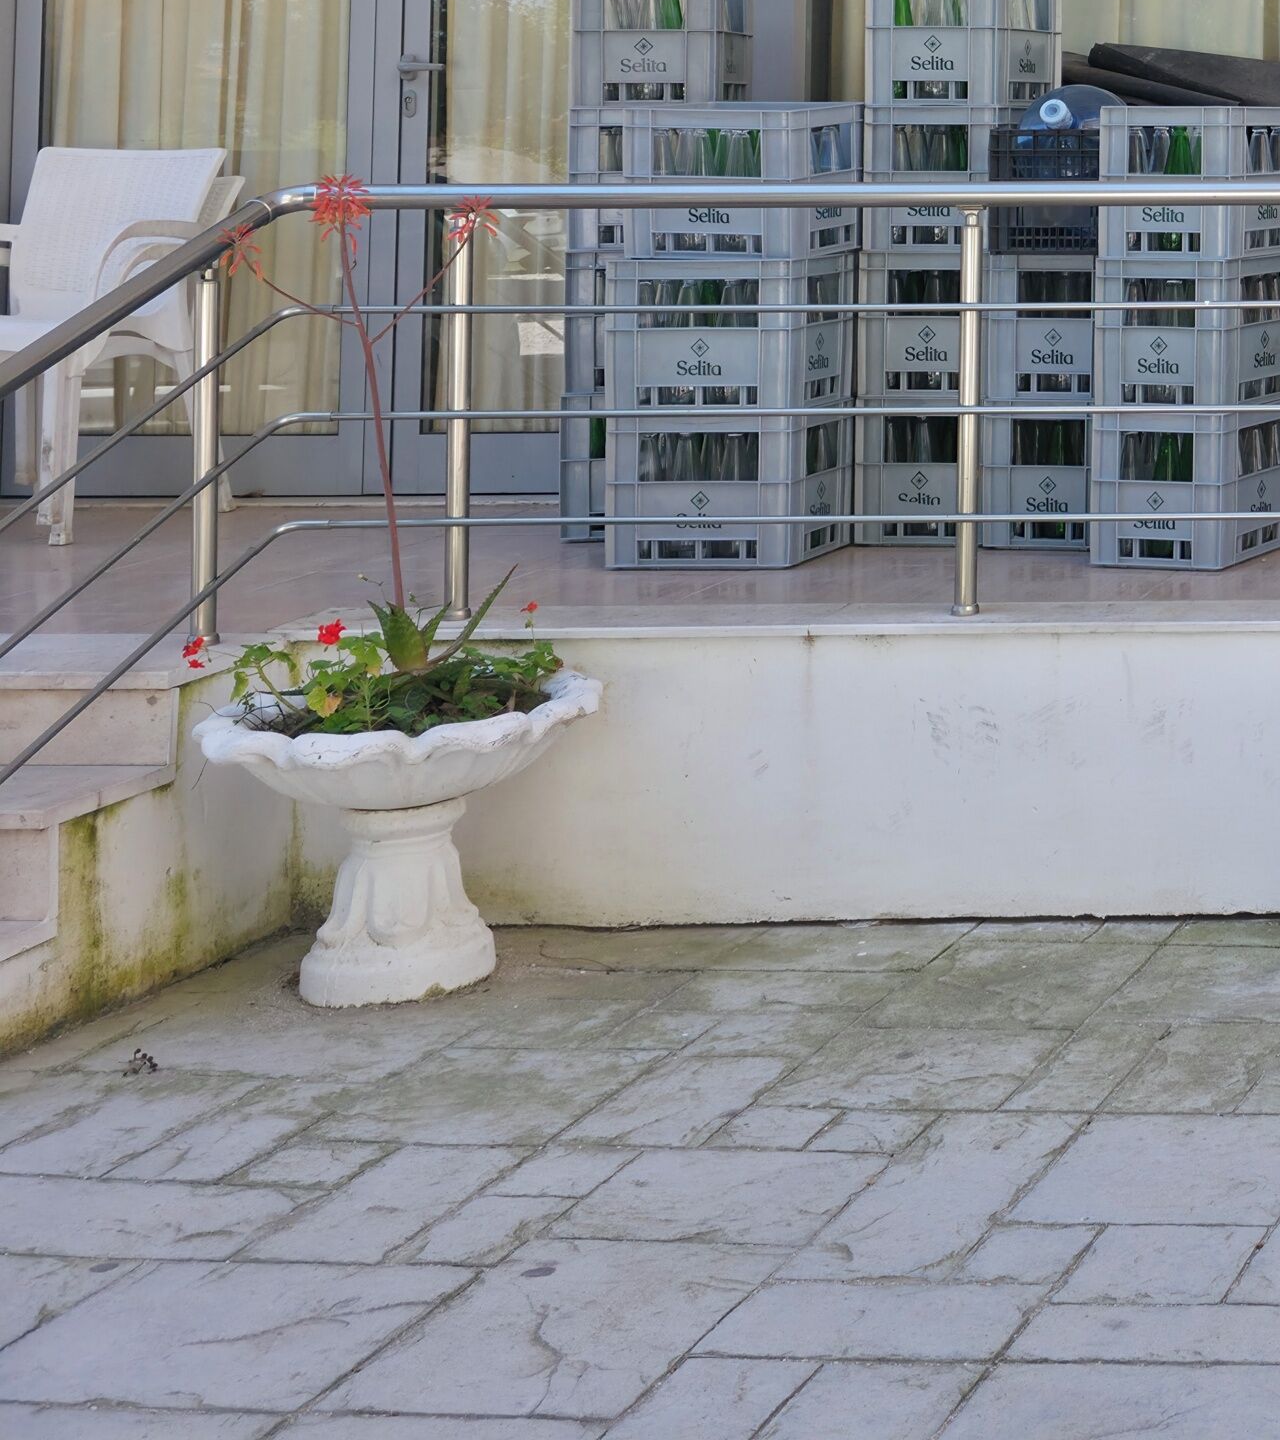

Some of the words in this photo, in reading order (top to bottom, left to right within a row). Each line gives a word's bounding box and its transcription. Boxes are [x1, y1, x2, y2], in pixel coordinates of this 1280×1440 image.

[619, 58, 667, 74] Selita
[910, 54, 954, 71] Selita
[1018, 57, 1036, 74] Selita
[688, 207, 730, 225] Selita
[1142, 206, 1185, 223] Selita
[1256, 204, 1278, 221] Selita
[807, 354, 829, 370] Selita
[905, 345, 948, 362] Selita
[1031, 348, 1074, 365] Selita
[1253, 351, 1276, 369] Selita
[676, 360, 722, 377] Selita
[1137, 357, 1180, 375] Selita
[1025, 497, 1068, 513] Selita
